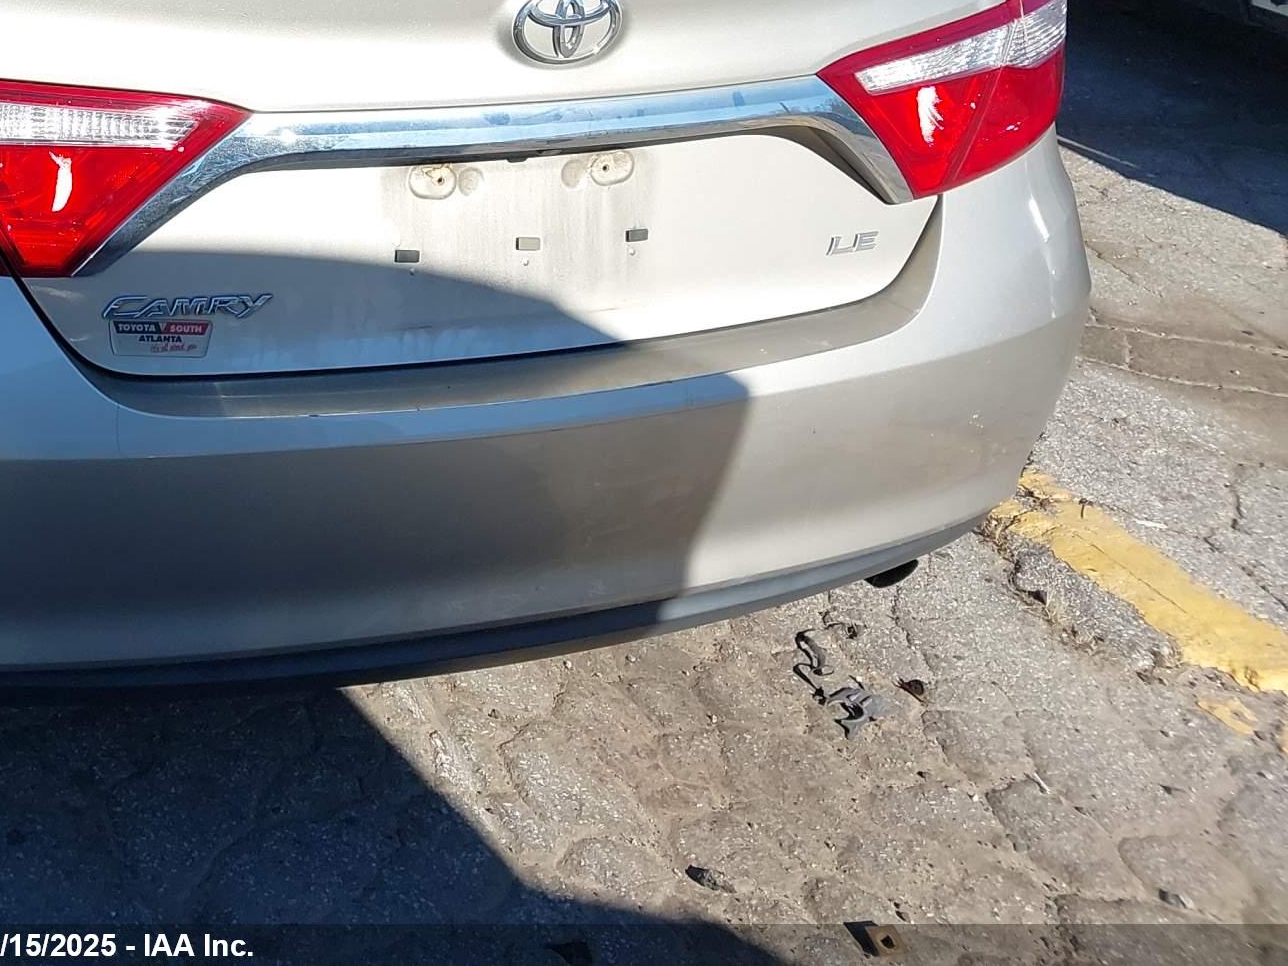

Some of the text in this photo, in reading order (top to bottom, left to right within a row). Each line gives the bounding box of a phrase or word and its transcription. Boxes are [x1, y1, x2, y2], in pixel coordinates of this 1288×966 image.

[825, 230, 879, 256] LE
[102, 293, 273, 319] CAMRY
[118, 323, 202, 333] TOYOTA SOUTH
[138, 335, 183, 343] ATLANTA
